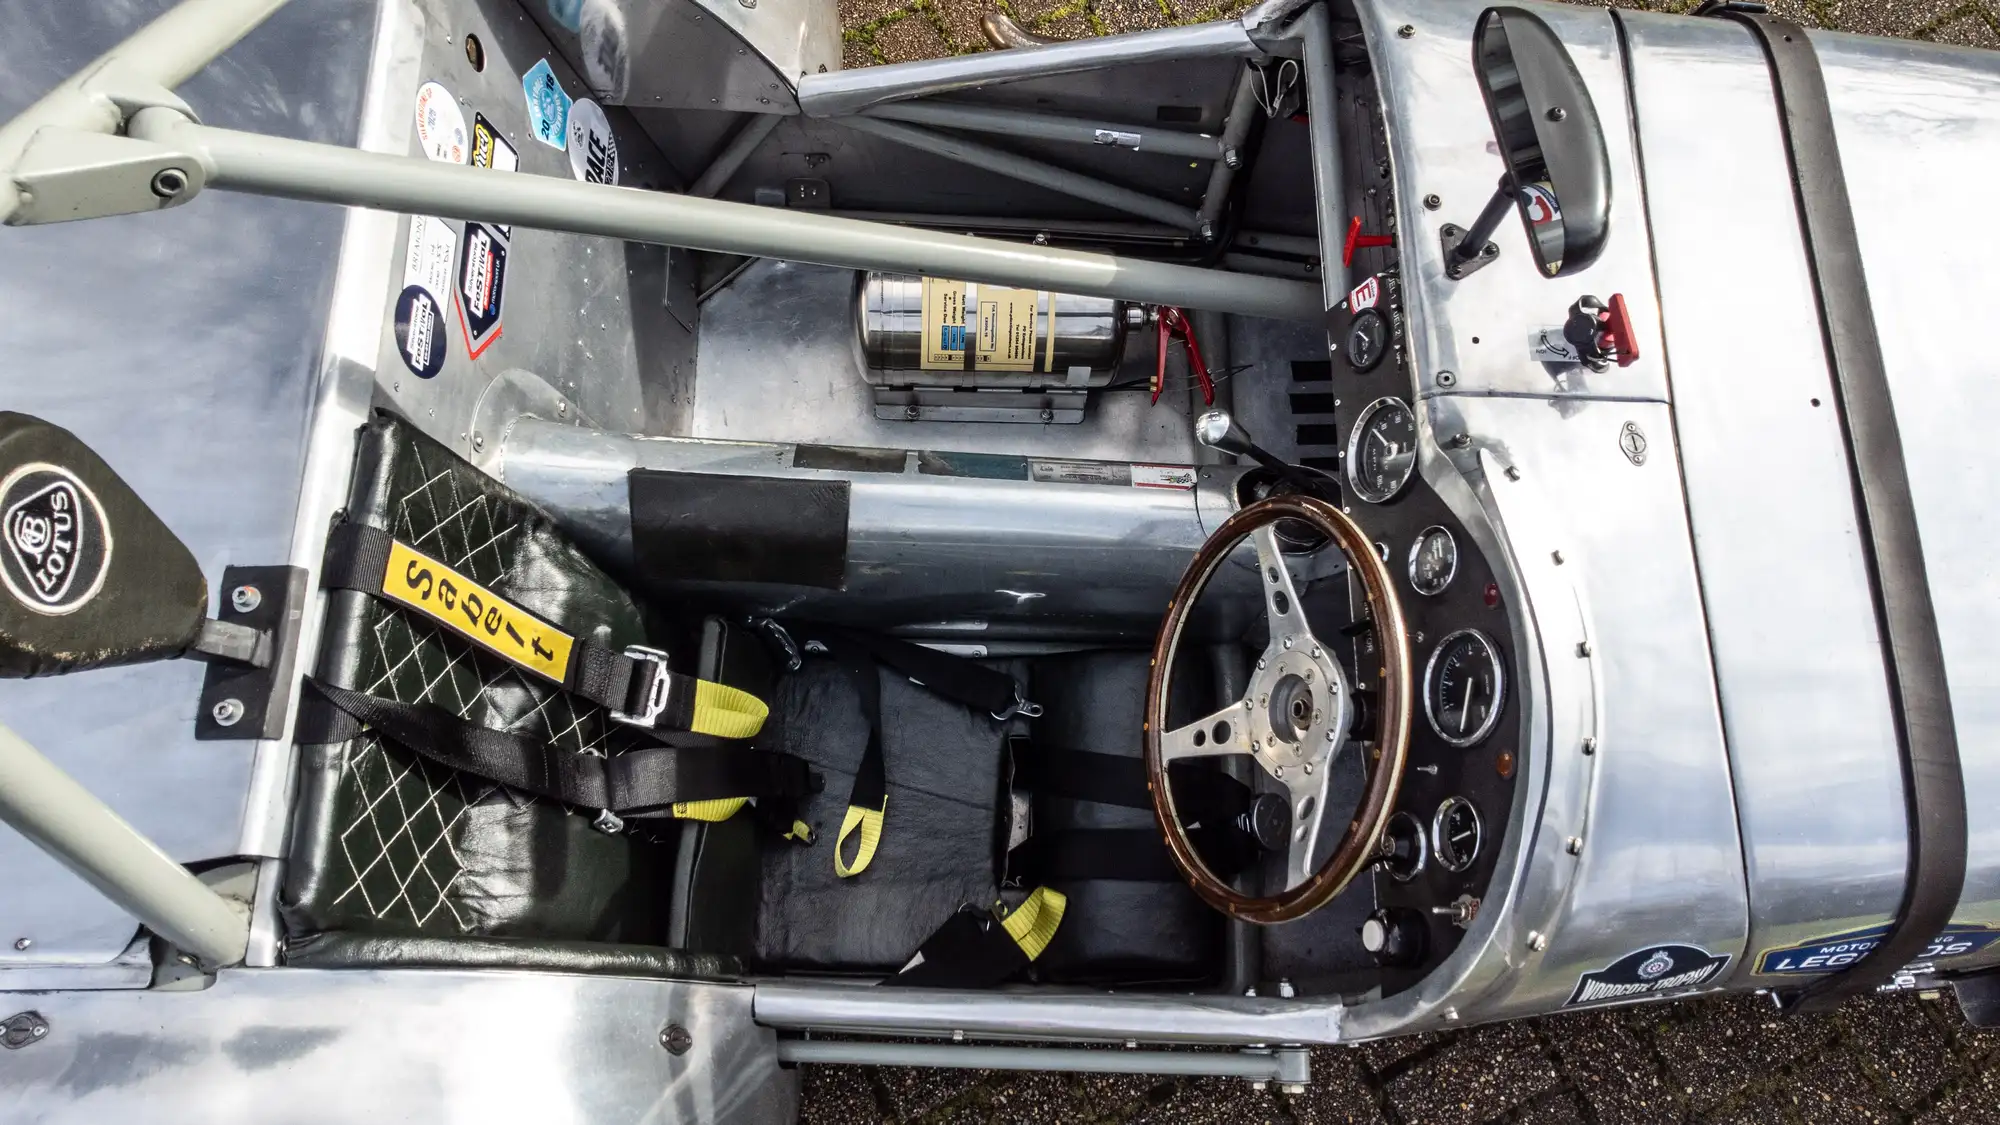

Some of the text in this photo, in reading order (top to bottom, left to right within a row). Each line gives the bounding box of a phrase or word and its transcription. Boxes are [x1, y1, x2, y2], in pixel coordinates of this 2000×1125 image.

[541, 74, 555, 140] 20 18
[467, 242, 479, 292] Silverstone
[409, 304, 420, 350] Silverstone
[36, 491, 72, 592] LOTUS
[406, 559, 555, 662] Sabelt
[1579, 962, 1719, 1002] WOODCOTE TROPHY
